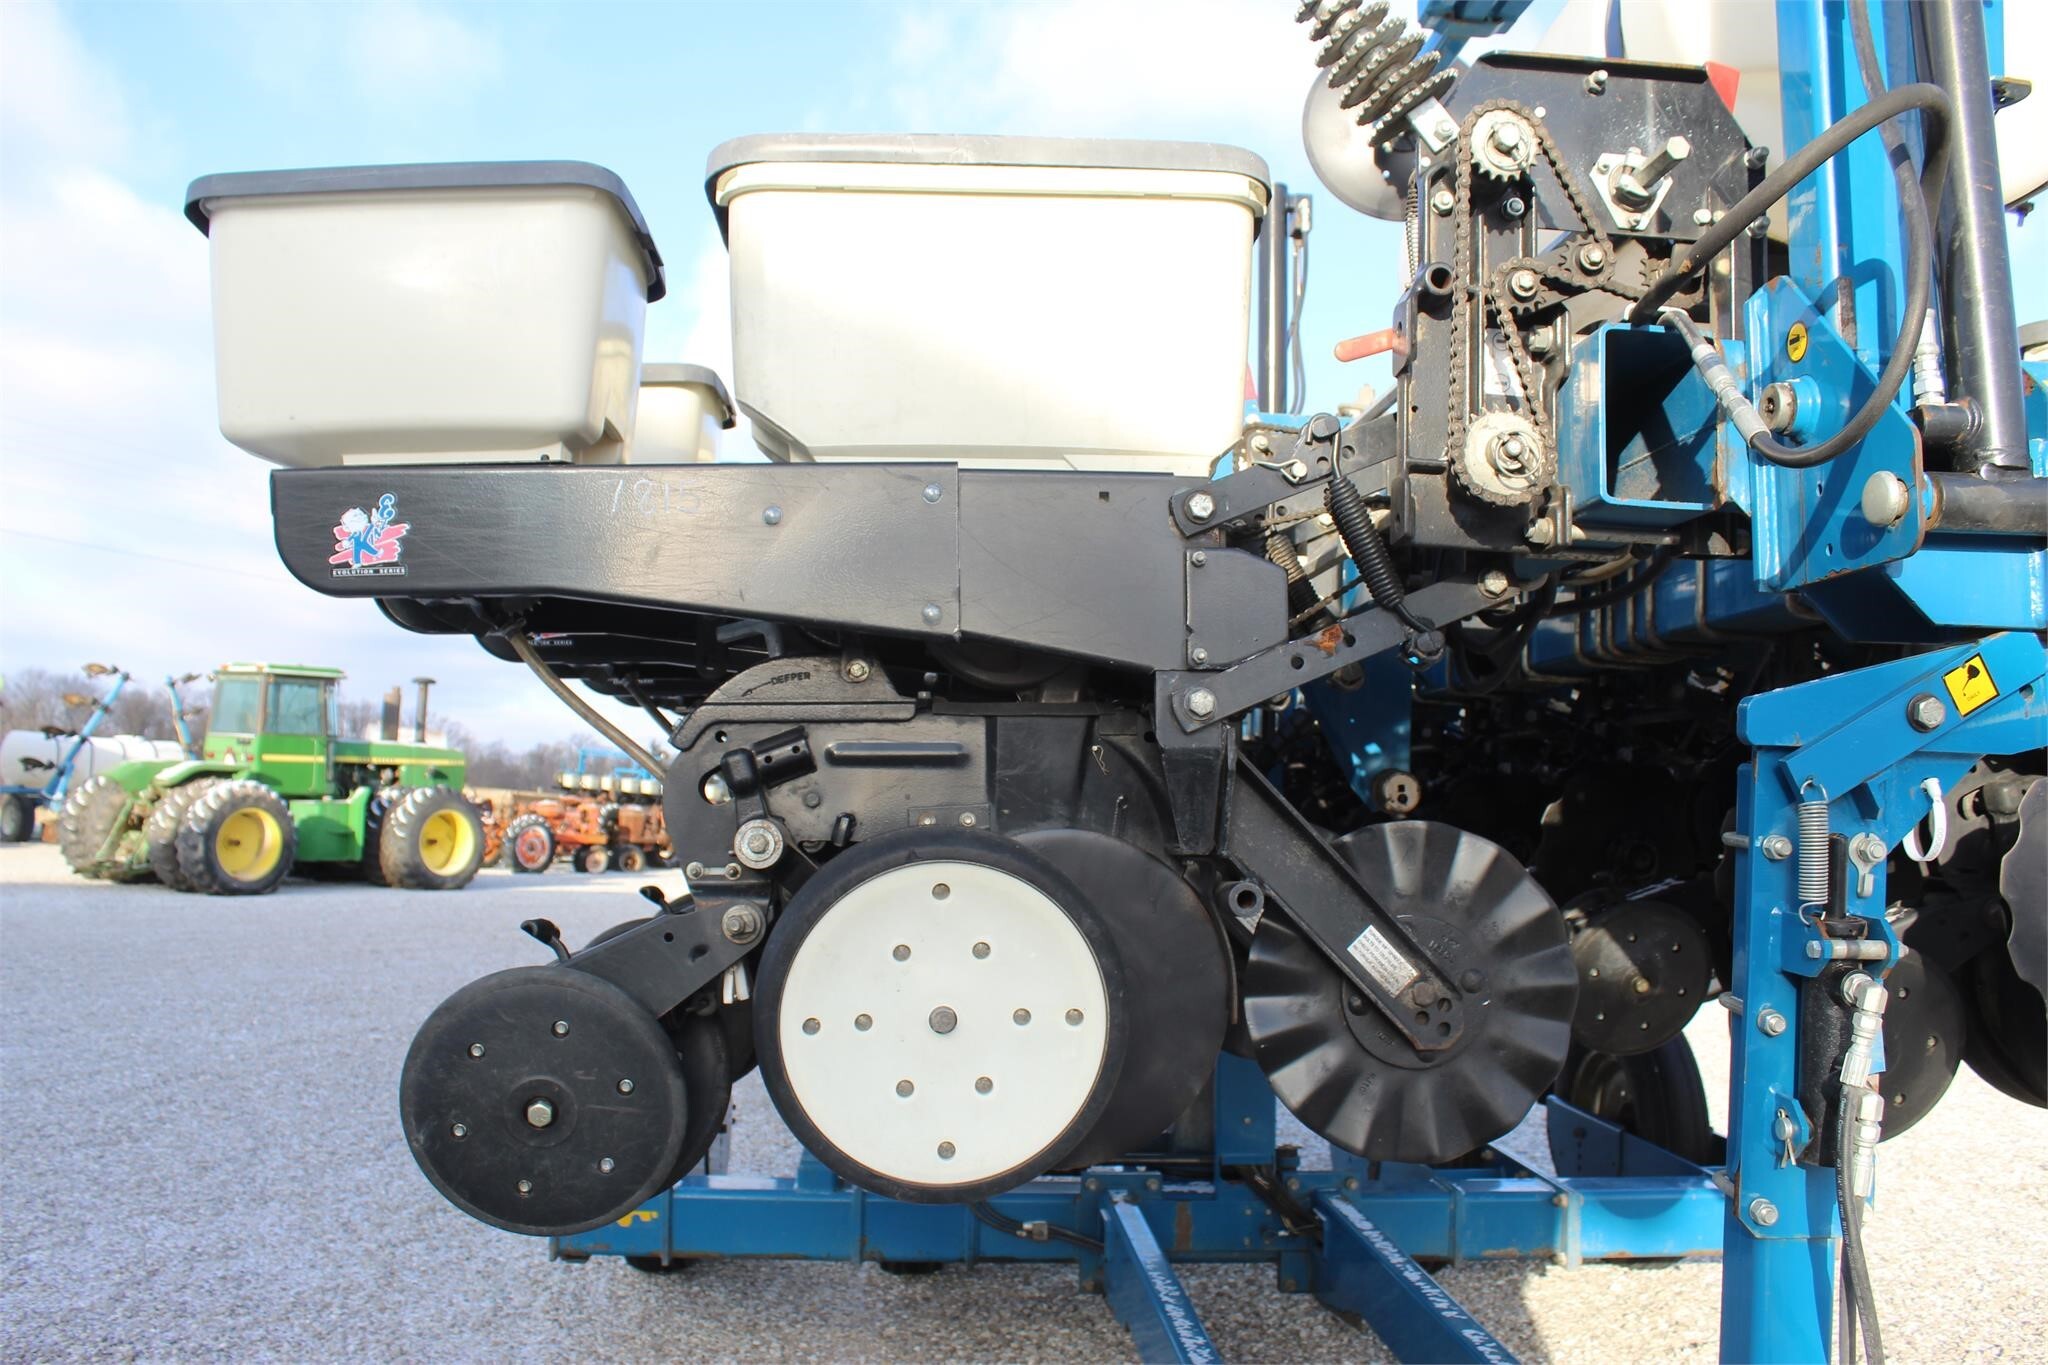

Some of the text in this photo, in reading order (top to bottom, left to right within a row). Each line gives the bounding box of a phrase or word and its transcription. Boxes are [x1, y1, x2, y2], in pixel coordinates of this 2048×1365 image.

[332, 567, 405, 576] EVOLUTION SERIES
[770, 671, 811, 685] DEEPER
